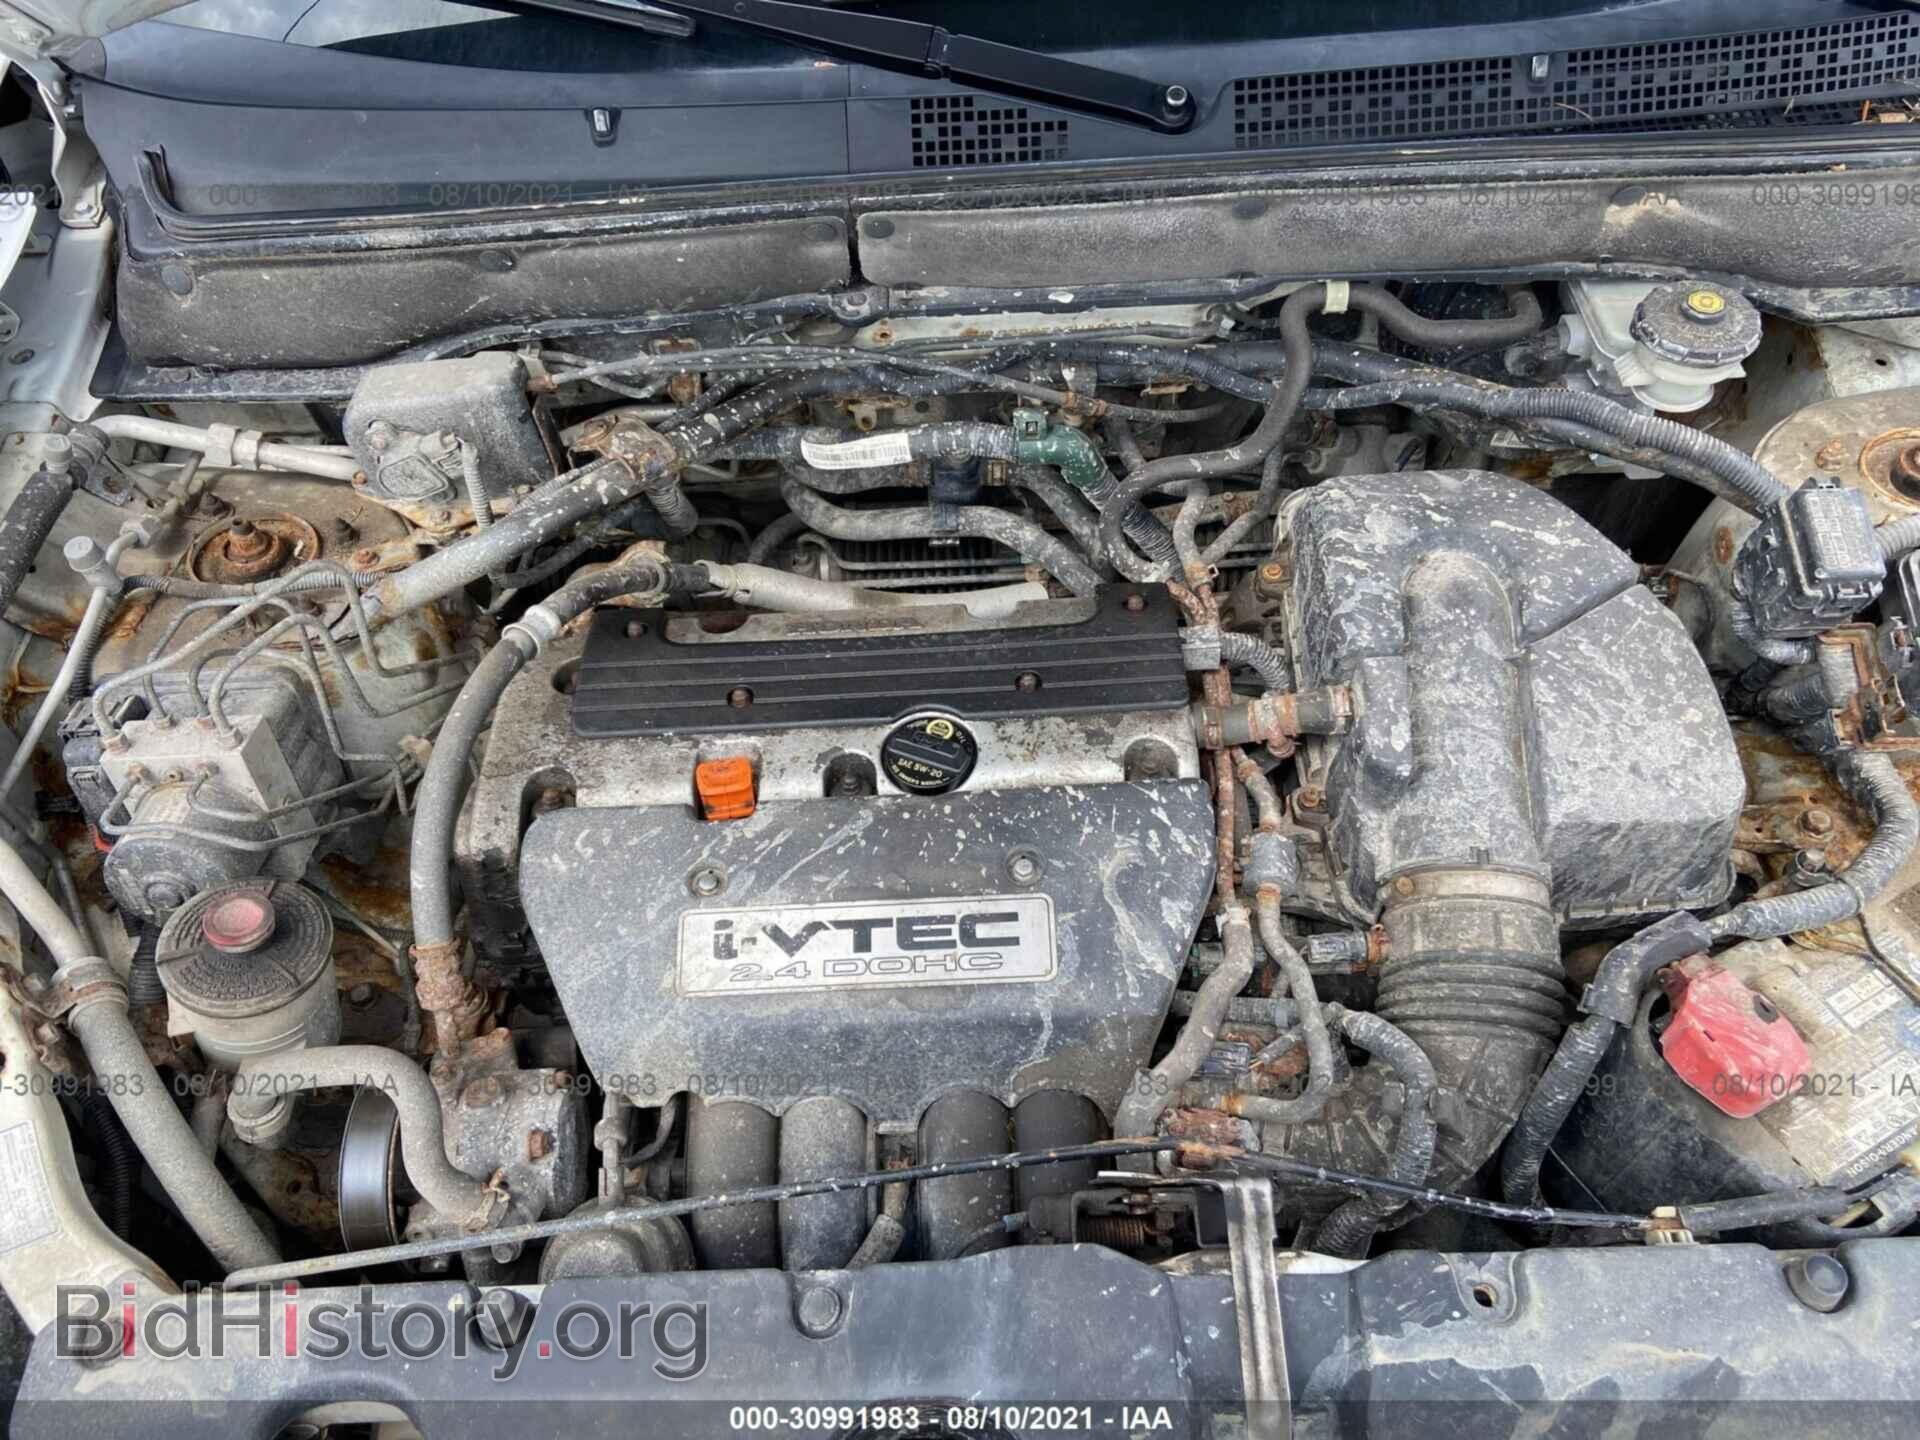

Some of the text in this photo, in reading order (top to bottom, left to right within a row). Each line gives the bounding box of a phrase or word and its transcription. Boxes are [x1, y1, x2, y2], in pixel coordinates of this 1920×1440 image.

[912, 762, 943, 778] 5W-20
[712, 911, 1021, 962] i-VTEC
[729, 952, 1004, 983] 2.4 DOHC
